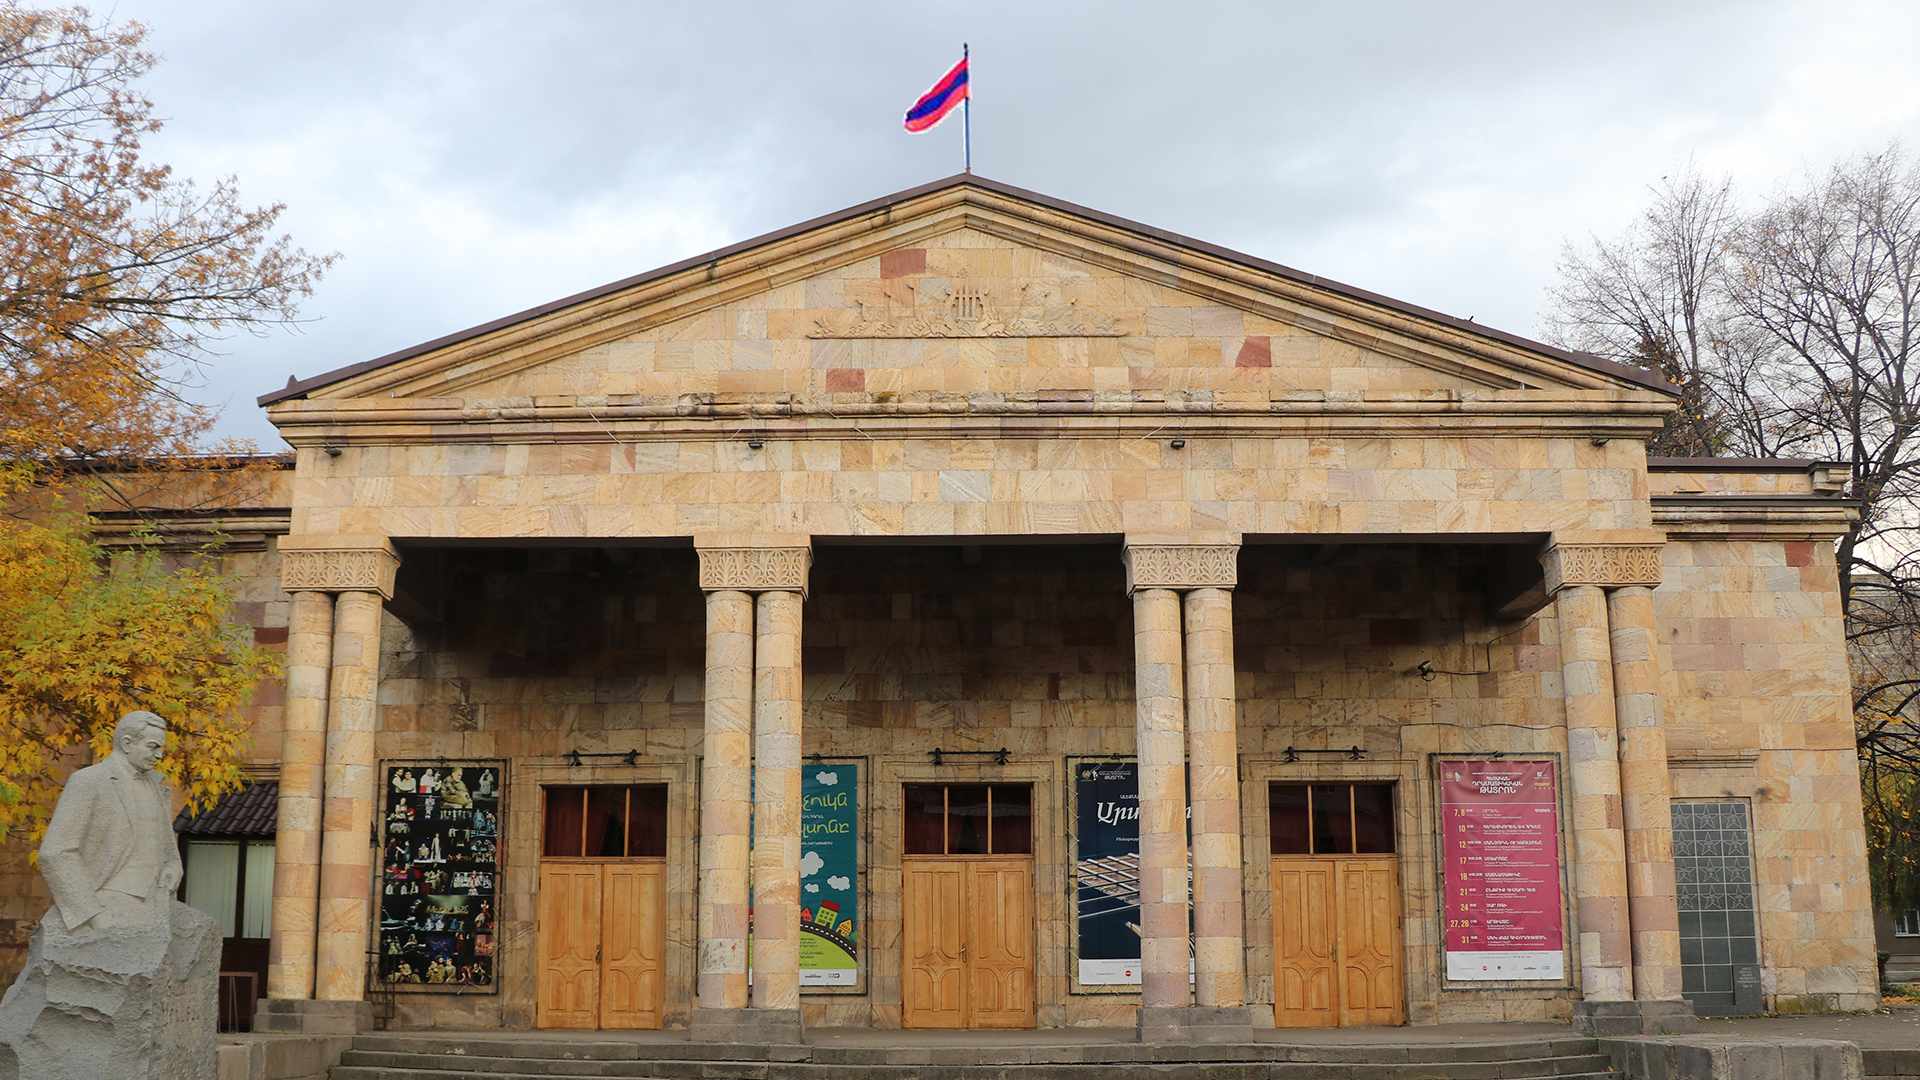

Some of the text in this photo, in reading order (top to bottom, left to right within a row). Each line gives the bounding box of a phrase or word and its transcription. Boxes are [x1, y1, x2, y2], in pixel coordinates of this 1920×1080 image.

[1479, 786, 1517, 794] ԹԱՏՐՈՆ
[1459, 840, 1466, 848] 12
[1459, 856, 1467, 864] 17
[1459, 888, 1468, 896] 21
